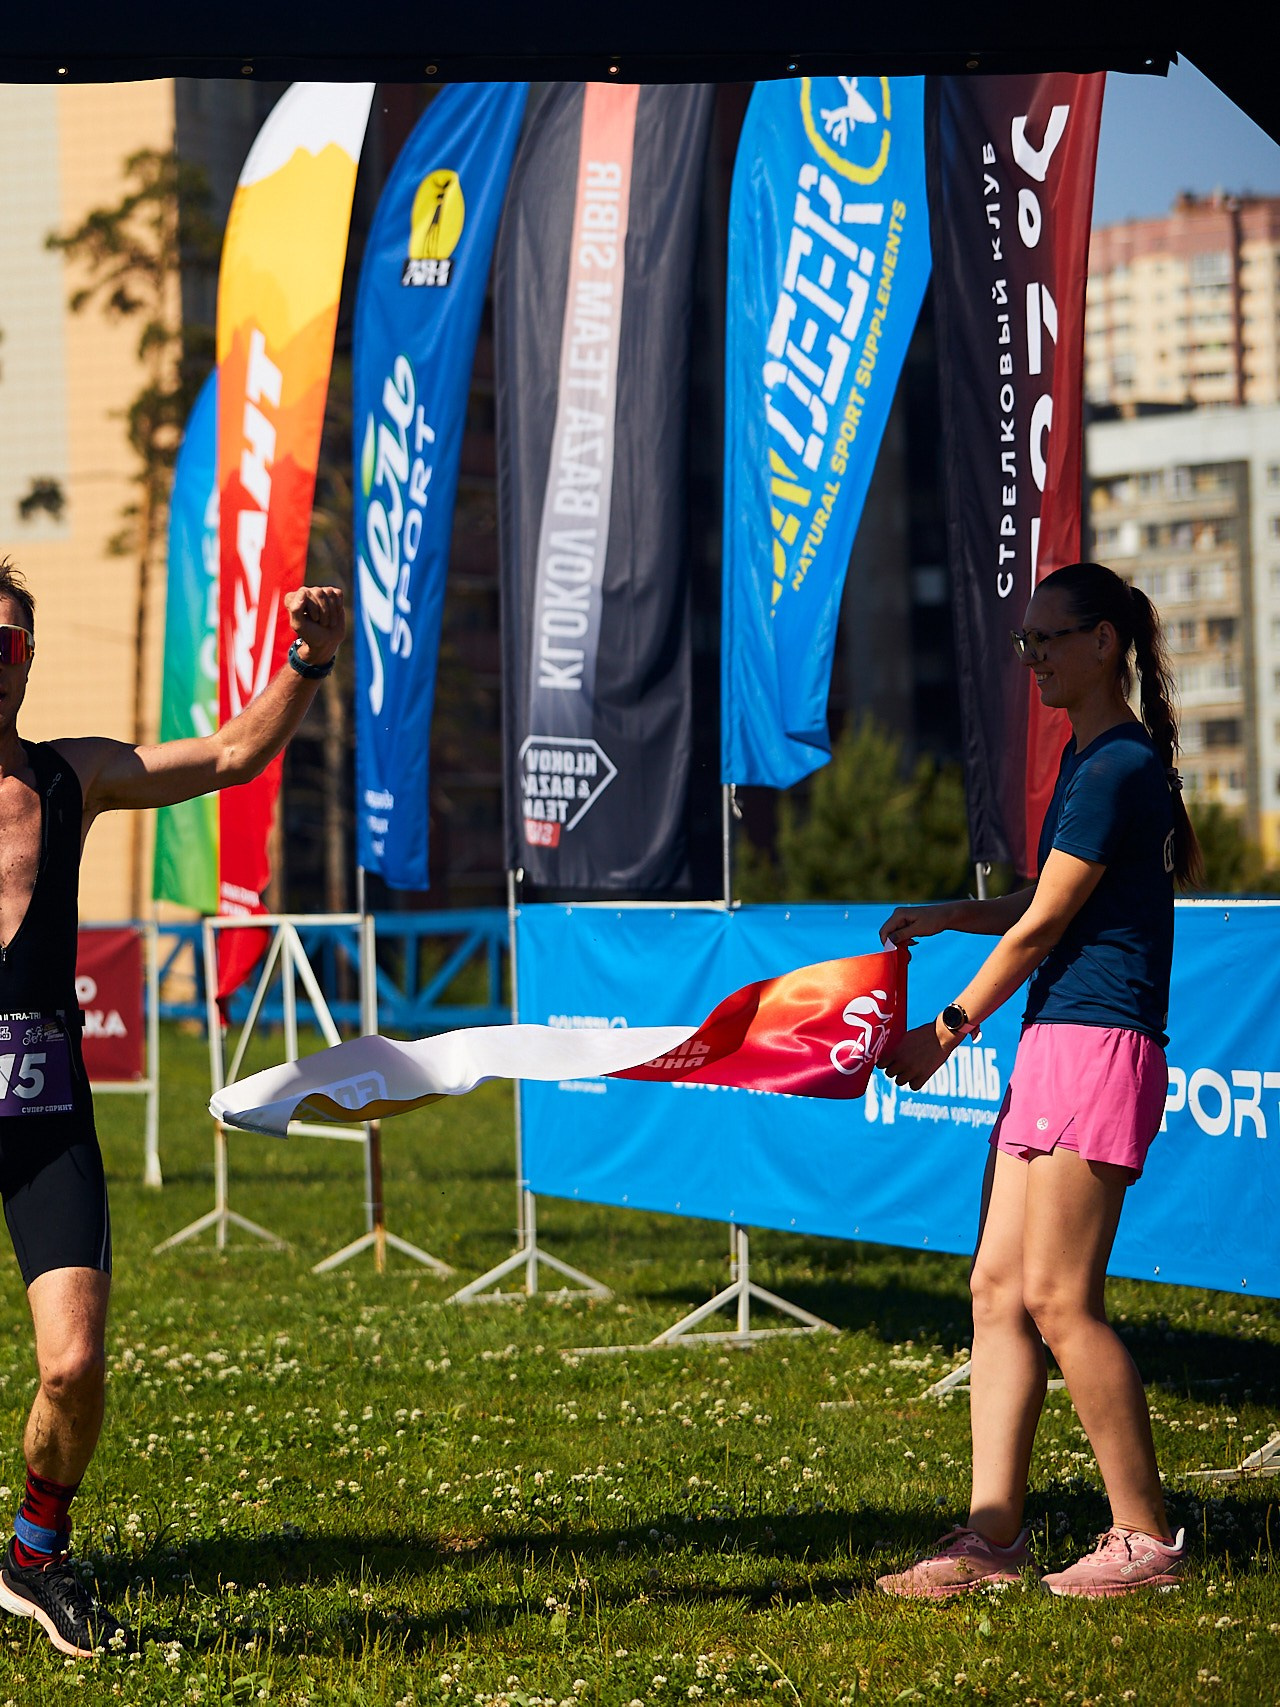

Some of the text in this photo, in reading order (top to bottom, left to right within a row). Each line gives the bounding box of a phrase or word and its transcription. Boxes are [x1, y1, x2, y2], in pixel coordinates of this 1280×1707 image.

[390, 404, 435, 659] SPORT
[792, 199, 906, 591] NATURAL SPORT SUPPLEMENTS
[982, 142, 1018, 599] СТРЕЛКОВЫЙ КЛУБ
